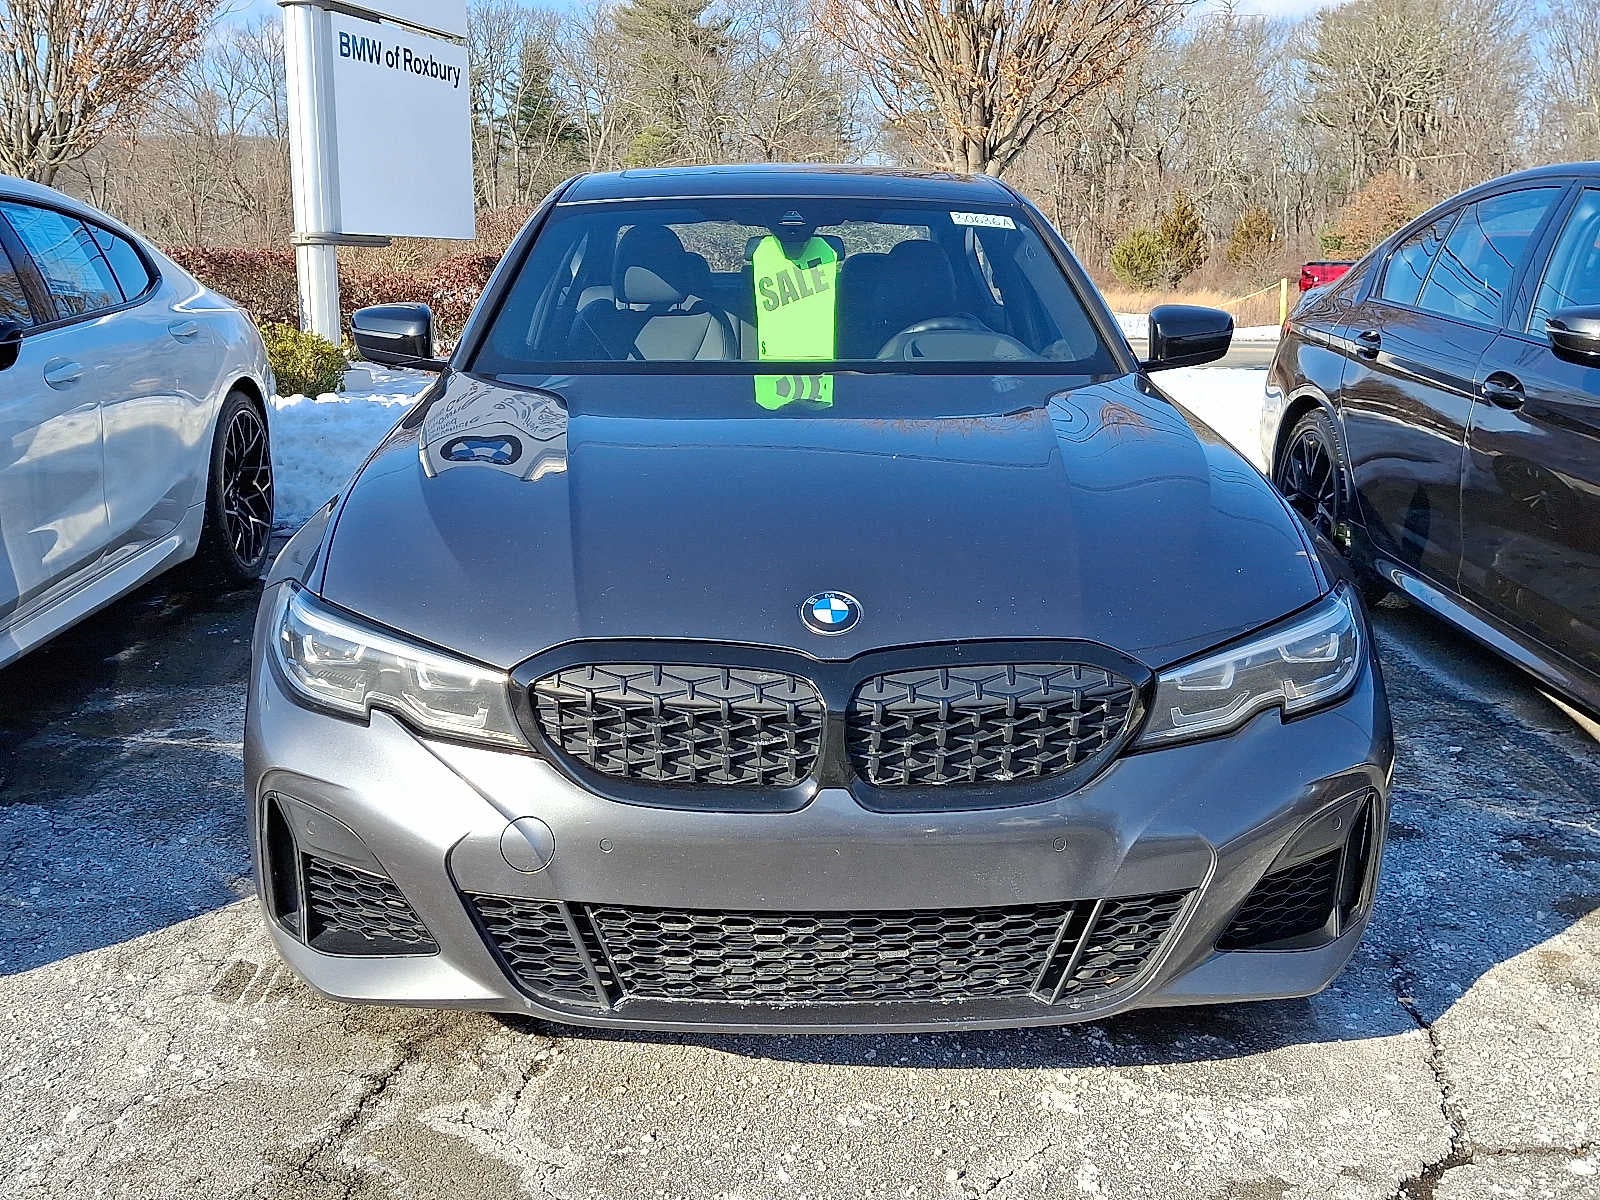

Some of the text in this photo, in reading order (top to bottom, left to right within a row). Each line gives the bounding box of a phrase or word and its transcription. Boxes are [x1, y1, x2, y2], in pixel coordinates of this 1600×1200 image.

[338, 31, 461, 88] BMW of Roxbury
[758, 258, 830, 312] SALE
[761, 340, 767, 355] $
